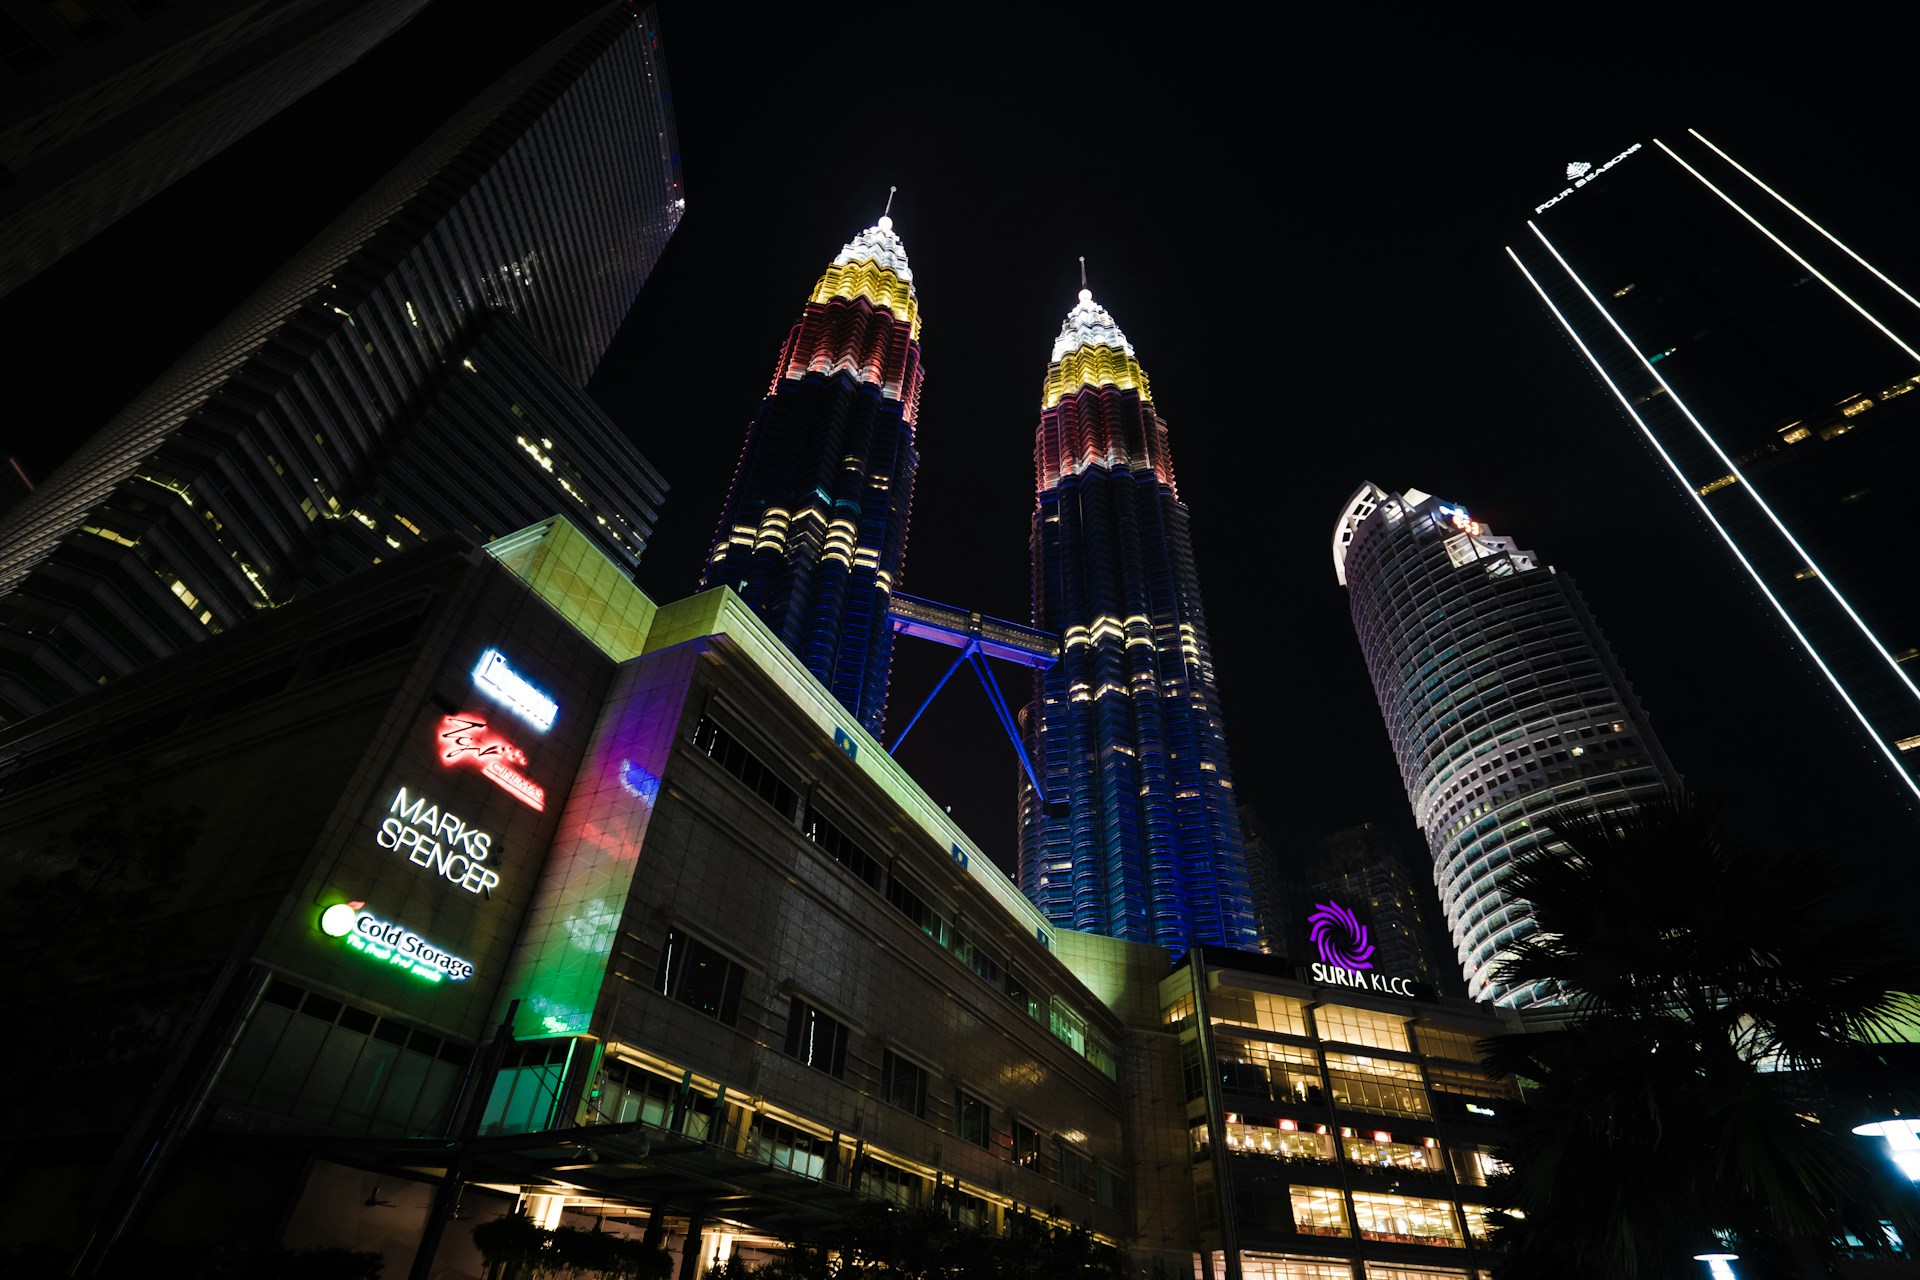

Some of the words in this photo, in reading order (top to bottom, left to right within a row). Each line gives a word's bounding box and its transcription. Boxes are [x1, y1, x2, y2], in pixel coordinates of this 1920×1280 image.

[1535, 188, 1574, 214] FOUR
[1575, 143, 1642, 188] SEASONS
[492, 762, 543, 799] CINEMAS
[390, 786, 491, 861] MARKS
[376, 818, 500, 899] SPENCER
[357, 916, 403, 946] Cold
[402, 936, 473, 978] Storage
[1311, 962, 1369, 990] SURIA
[1371, 973, 1415, 997] KLCC
